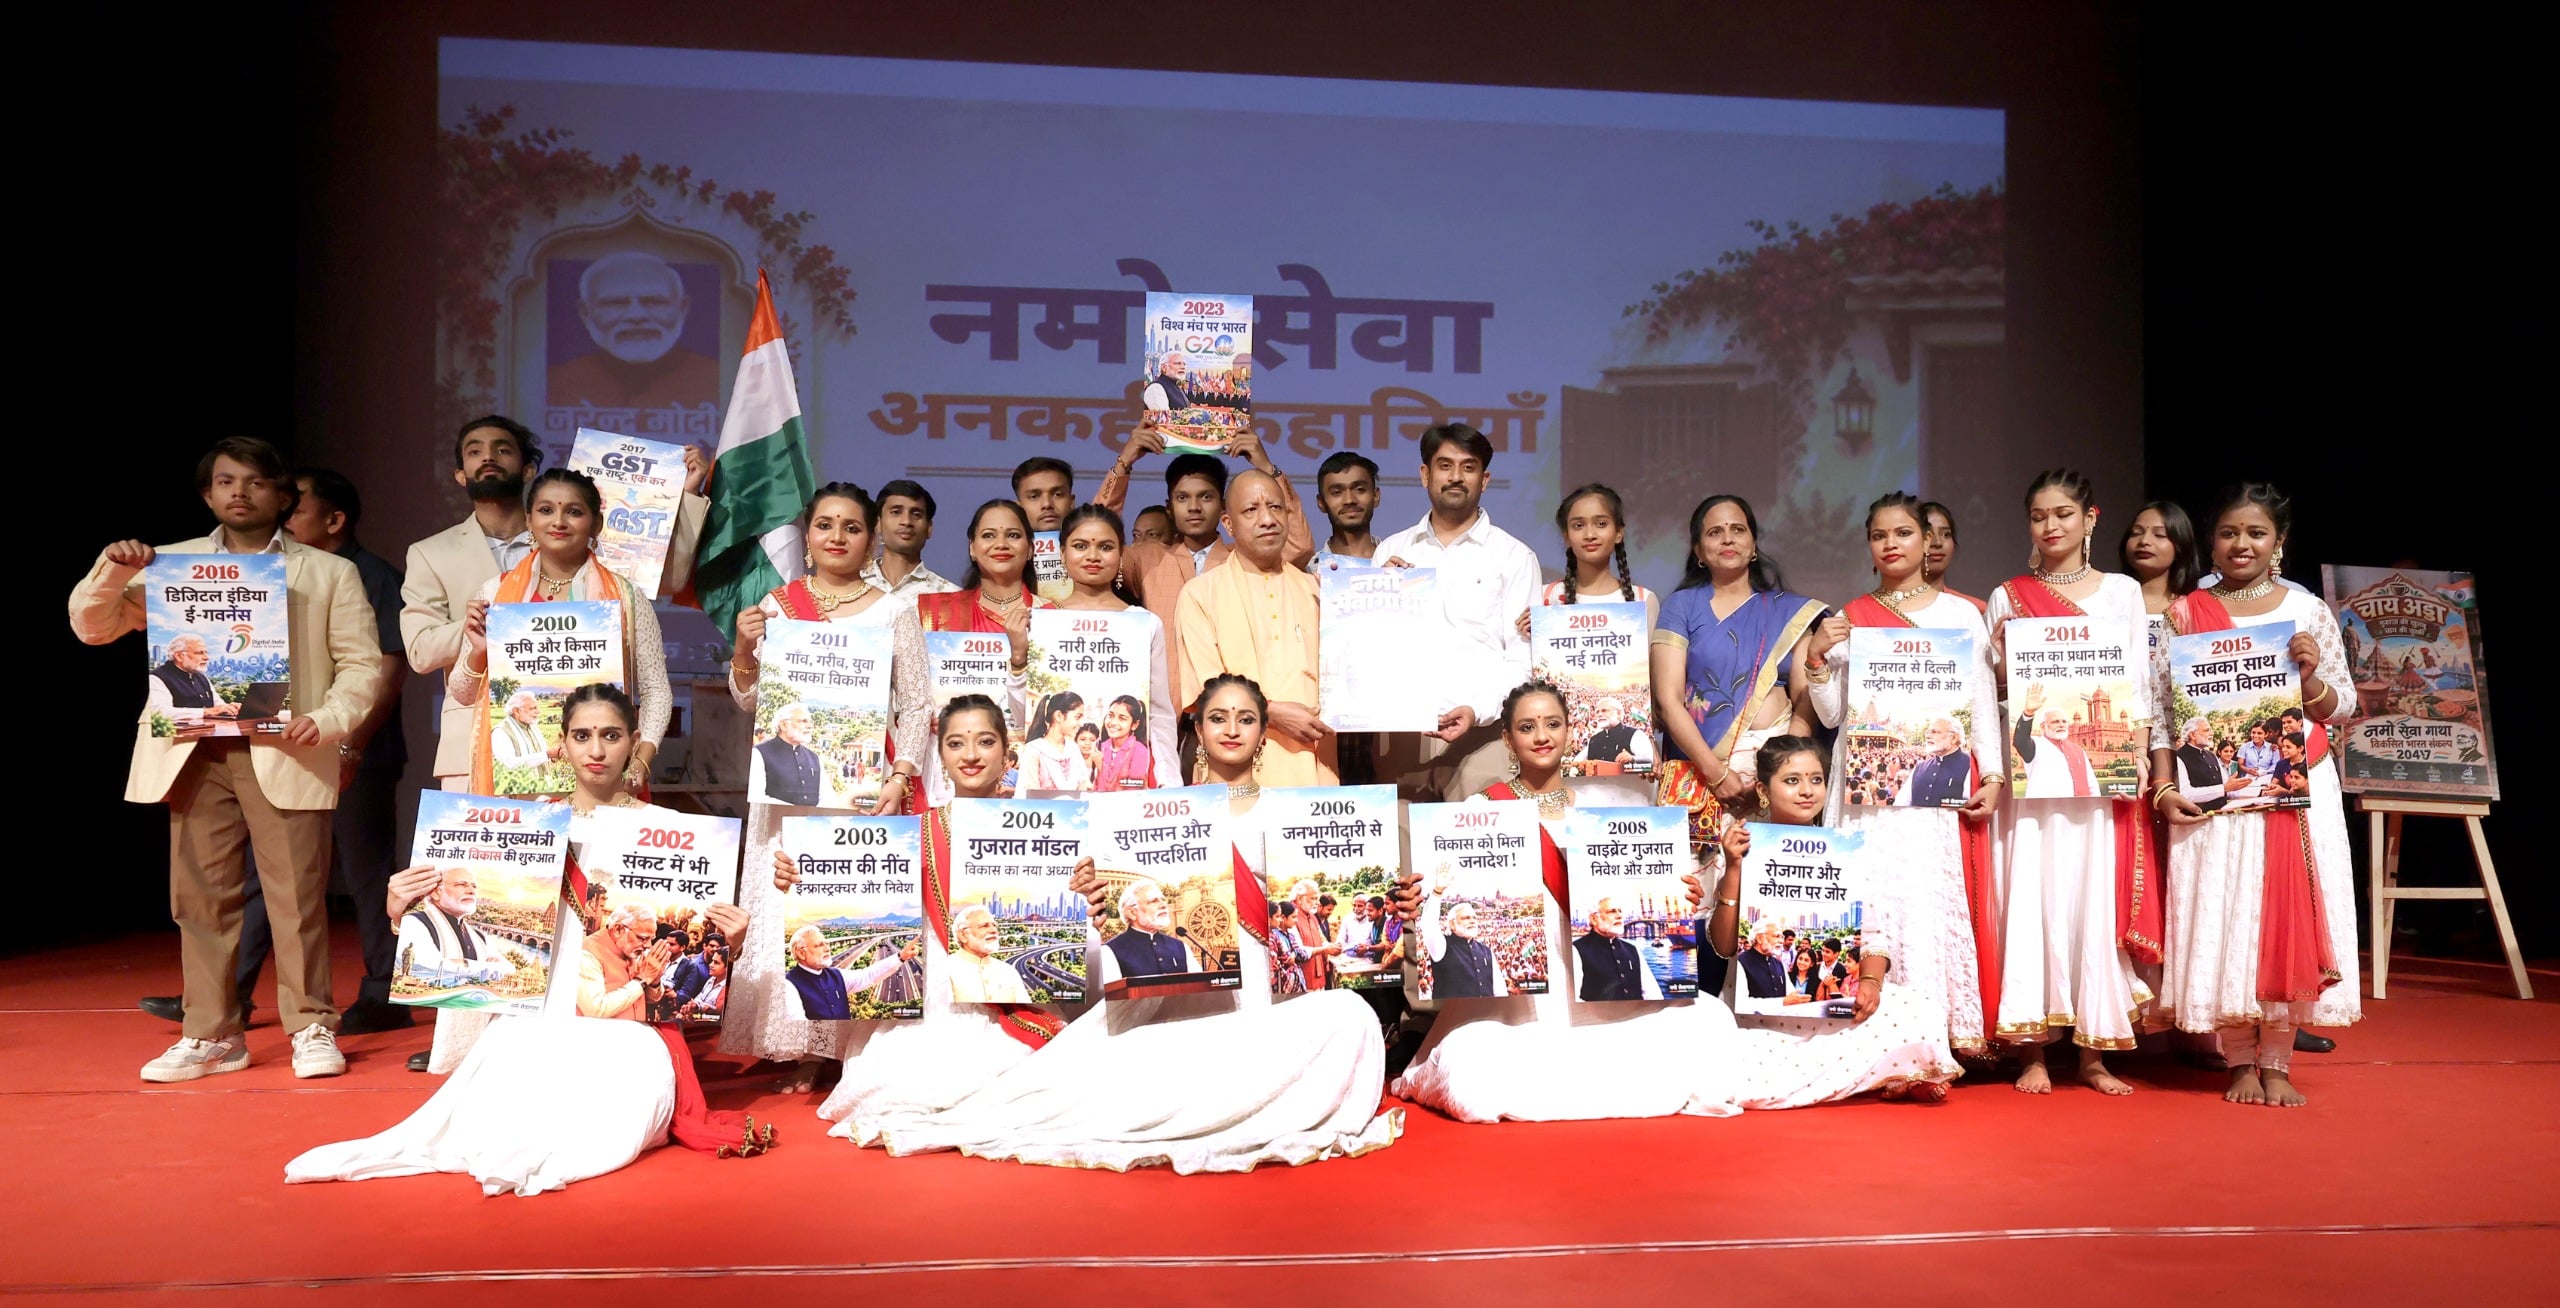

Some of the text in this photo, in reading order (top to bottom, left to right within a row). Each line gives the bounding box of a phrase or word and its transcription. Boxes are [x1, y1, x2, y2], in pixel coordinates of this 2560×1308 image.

[1184, 301, 1224, 315] 2023
[1161, 317, 1247, 333] विश्व मंच पर भारत
[1252, 264, 1494, 373] सेवा
[867, 380, 1145, 452] अनकह
[620, 444, 646, 454] 2017
[601, 452, 658, 476] GST
[586, 466, 603, 476] एक
[631, 473, 647, 484] एक
[650, 477, 667, 487] कर
[607, 507, 668, 539] GST
[1035, 540, 1055, 553] 24
[192, 565, 239, 579] 2016
[165, 587, 268, 604] डिजिटल इंडिया
[2354, 597, 2400, 618] चाय
[531, 615, 577, 632] 2010
[1072, 619, 1108, 632] 2012
[1569, 614, 1608, 628] 2019
[810, 632, 848, 648] 2011
[1549, 631, 1632, 649] नया जनादेश
[2044, 626, 2089, 641] 2014
[504, 637, 607, 659] कृषि और किसान
[964, 640, 1003, 653] 2018
[1058, 636, 1121, 654] नारी शक्ति
[1893, 640, 1931, 653] 2013
[2016, 646, 2122, 662] भारत का प्रधान मंत्री
[2211, 637, 2252, 655] 2015
[514, 654, 602, 674] समृद्धि की ओर
[852, 658, 875, 674] युवा
[941, 660, 993, 674] आयुष्मान
[1049, 654, 1130, 673] देश की शक्ति
[1565, 649, 1617, 668] नई गति
[2192, 654, 2276, 677] सबका साथ
[1869, 660, 1956, 676] गुजरात से दिल्ली
[2016, 665, 2032, 680] नई
[2075, 666, 2094, 676] नया
[2098, 666, 2124, 676] भारत
[829, 670, 870, 688] विकास
[939, 676, 950, 686] हर
[953, 675, 984, 685] नागरिक
[987, 677, 998, 685] का
[1928, 678, 1941, 690] की
[1945, 679, 1962, 691] ओर
[2186, 672, 2287, 697] सबका विकास
[2364, 720, 2396, 737] नमो
[465, 808, 521, 824] 2001
[1143, 800, 1190, 818] 2005
[1310, 800, 1355, 816] 2006
[1002, 811, 1054, 829] 2004
[1454, 811, 1500, 828] 2007
[1608, 821, 1648, 835] 2008
[430, 827, 556, 849] गुजरात के मुख्यमंत्री
[834, 827, 888, 846] 2003
[1114, 819, 1212, 851] सुशासन और
[1282, 819, 1383, 840] जनभागीदारी से
[637, 827, 695, 851] 2002
[968, 835, 1080, 860] गुजरात मॉडल
[1433, 833, 1525, 851] विकास को मिला
[1782, 838, 1827, 855] 2009
[426, 845, 446, 859] सेवा
[447, 846, 466, 860] और
[468, 847, 502, 861] विकास
[503, 848, 517, 863] की
[1135, 842, 1207, 865] पारदर्शिता
[1304, 839, 1364, 859] परिवर्तन
[1632, 842, 1674, 860] गुजरात
[622, 851, 710, 875] संकट में भी
[797, 853, 911, 875] विकास की नींव
[965, 861, 1075, 876] विकास का नया अध्या
[1591, 861, 1620, 876] निवेश
[1624, 860, 1642, 876] और
[1765, 859, 1842, 880] रोजगार और
[619, 871, 718, 900] संकल्प अटूट
[861, 880, 881, 894] और
[884, 880, 914, 894] निवेश
[1758, 878, 1848, 901] कौशल पर जोर
